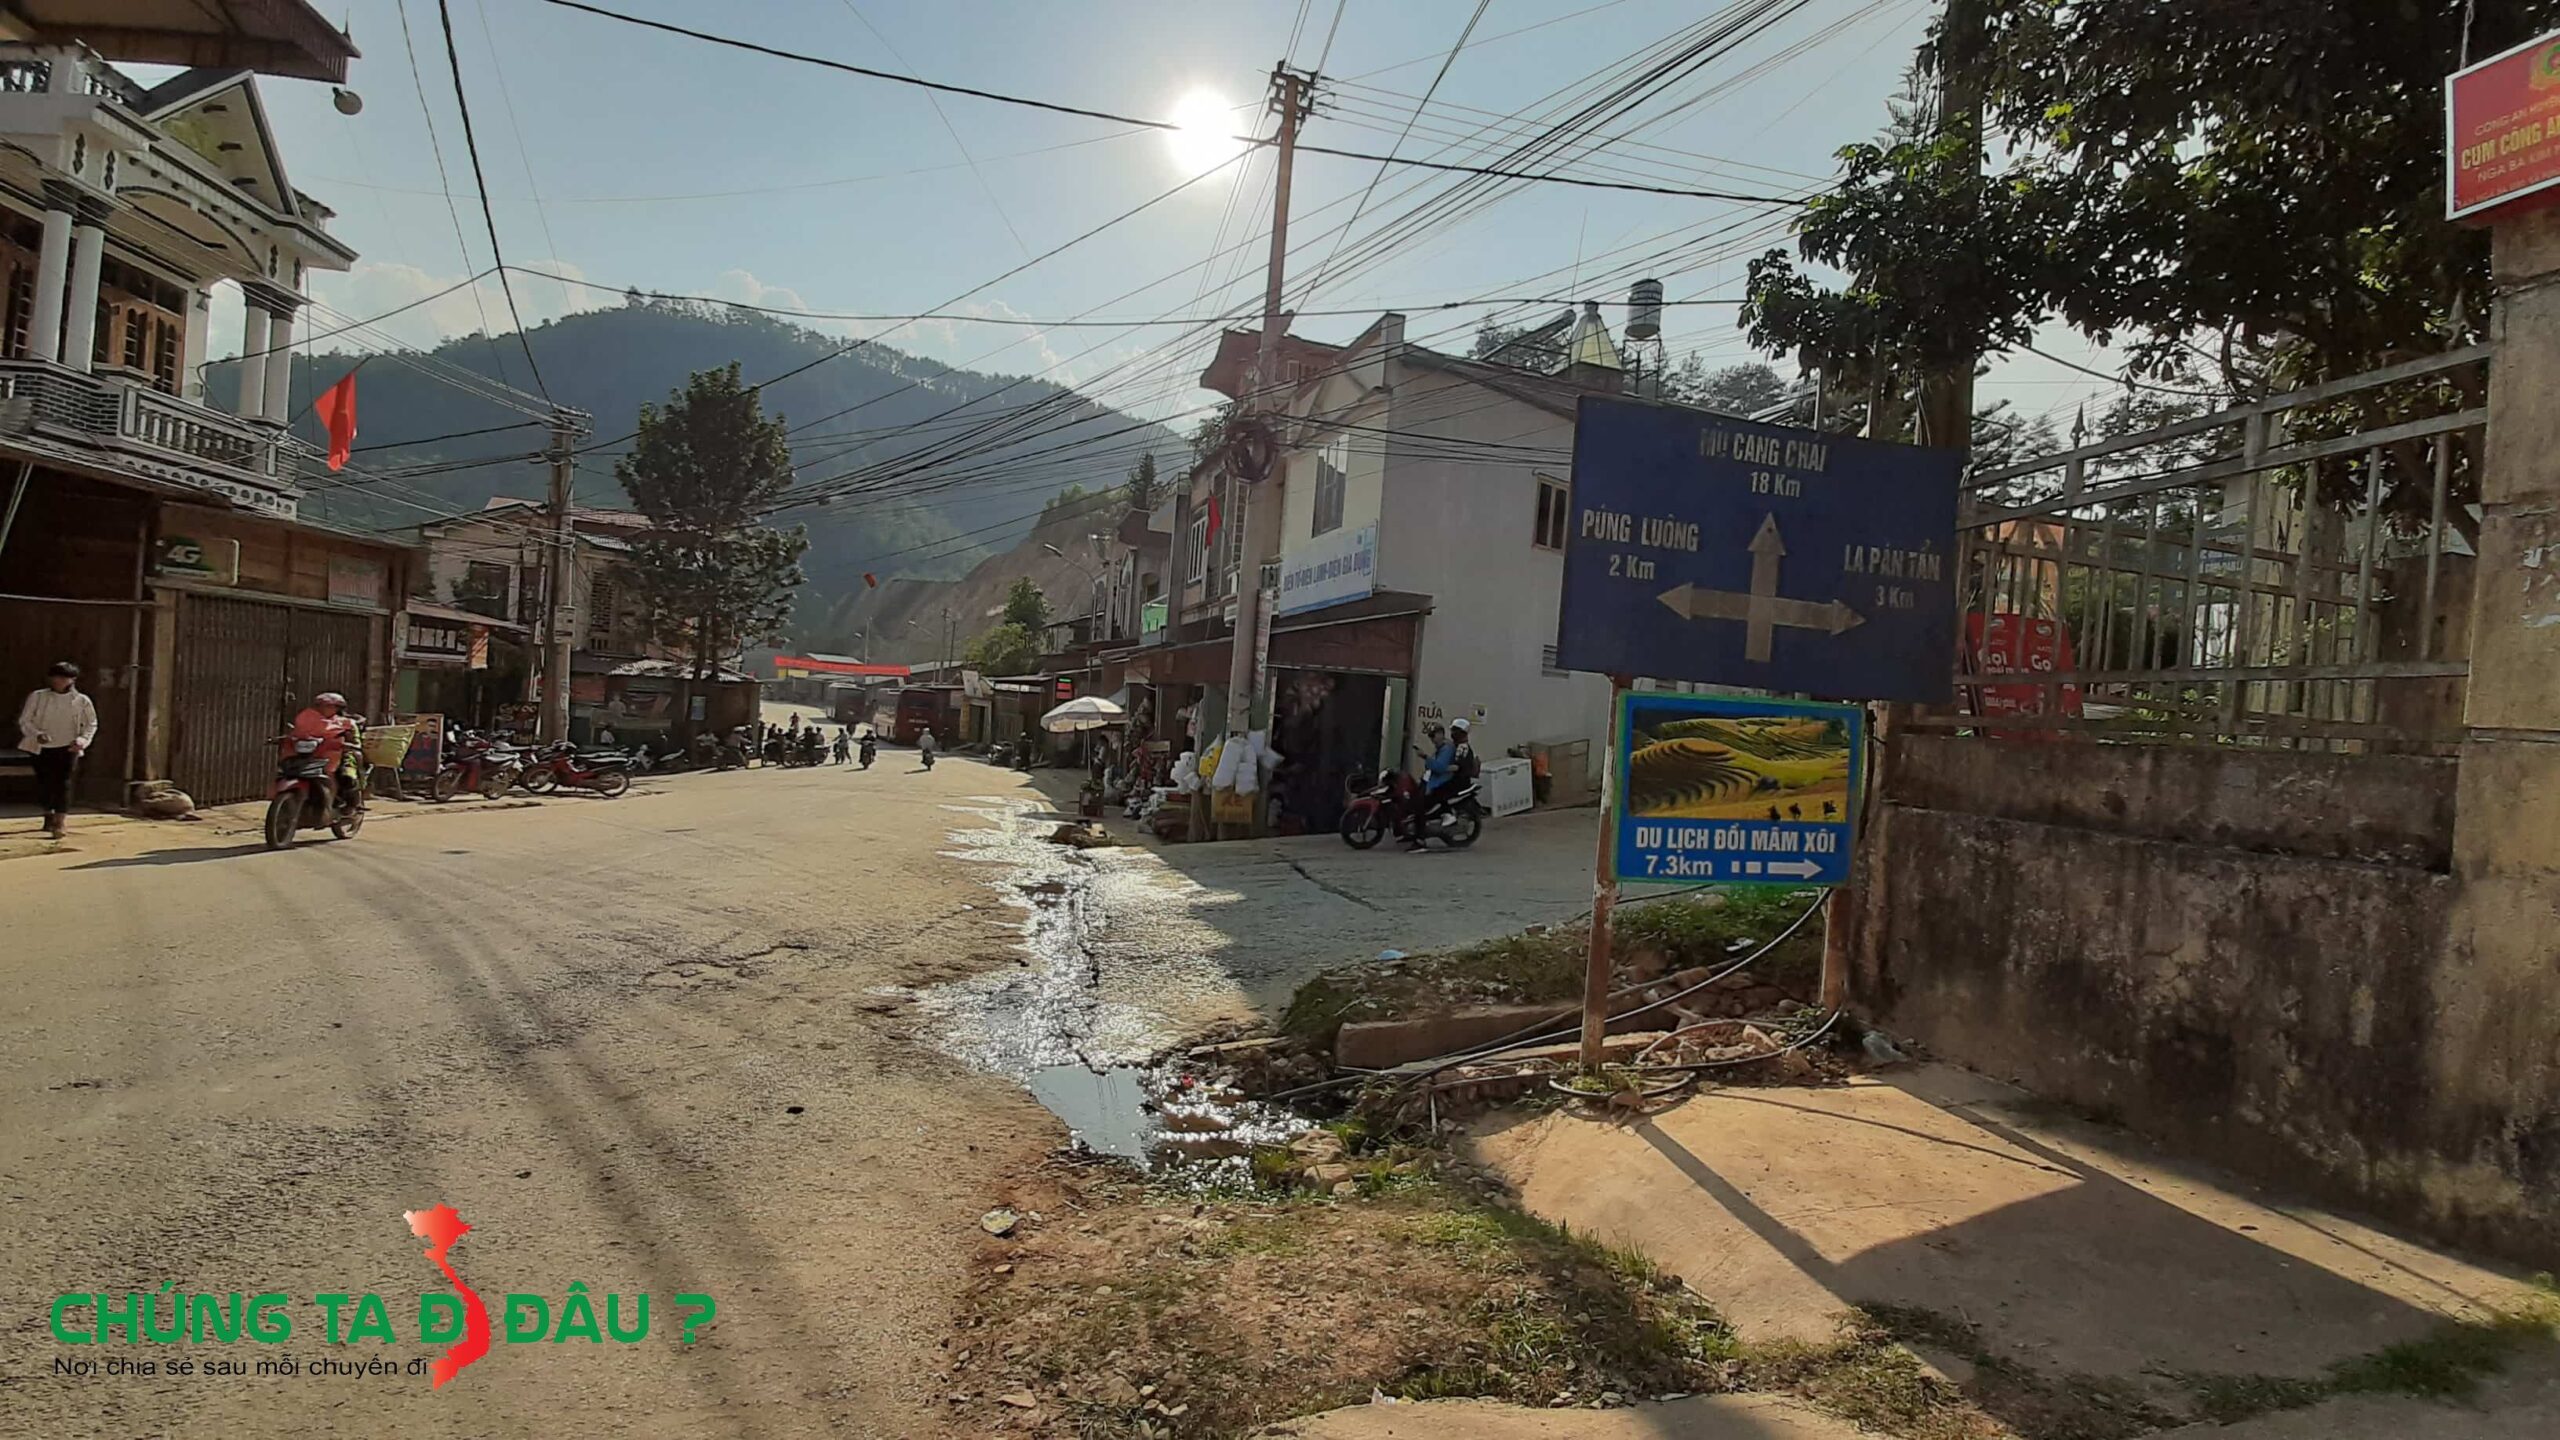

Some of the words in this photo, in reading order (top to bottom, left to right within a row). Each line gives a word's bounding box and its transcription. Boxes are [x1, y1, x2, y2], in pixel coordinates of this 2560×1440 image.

[2461, 138, 2496, 170] CỤM
[2500, 121, 2542, 155] CÔNG
[1733, 433, 1780, 467] CANG
[1750, 471, 1770, 494] 18
[1774, 474, 1800, 498] Km
[1641, 513, 1700, 552] LUÔNG
[167, 544, 202, 564] 4G
[1608, 554, 1621, 576] 2
[1626, 555, 1656, 580] Km
[1844, 543, 1864, 573] LA
[1875, 584, 1885, 607] 3
[1889, 586, 1914, 609] Km
[1636, 826, 1661, 849] DU
[1667, 827, 1709, 853] LỊCH
[1751, 827, 1799, 852] MÂM
[1804, 828, 1836, 853] XÔI
[1645, 855, 1713, 876] 7.3km
